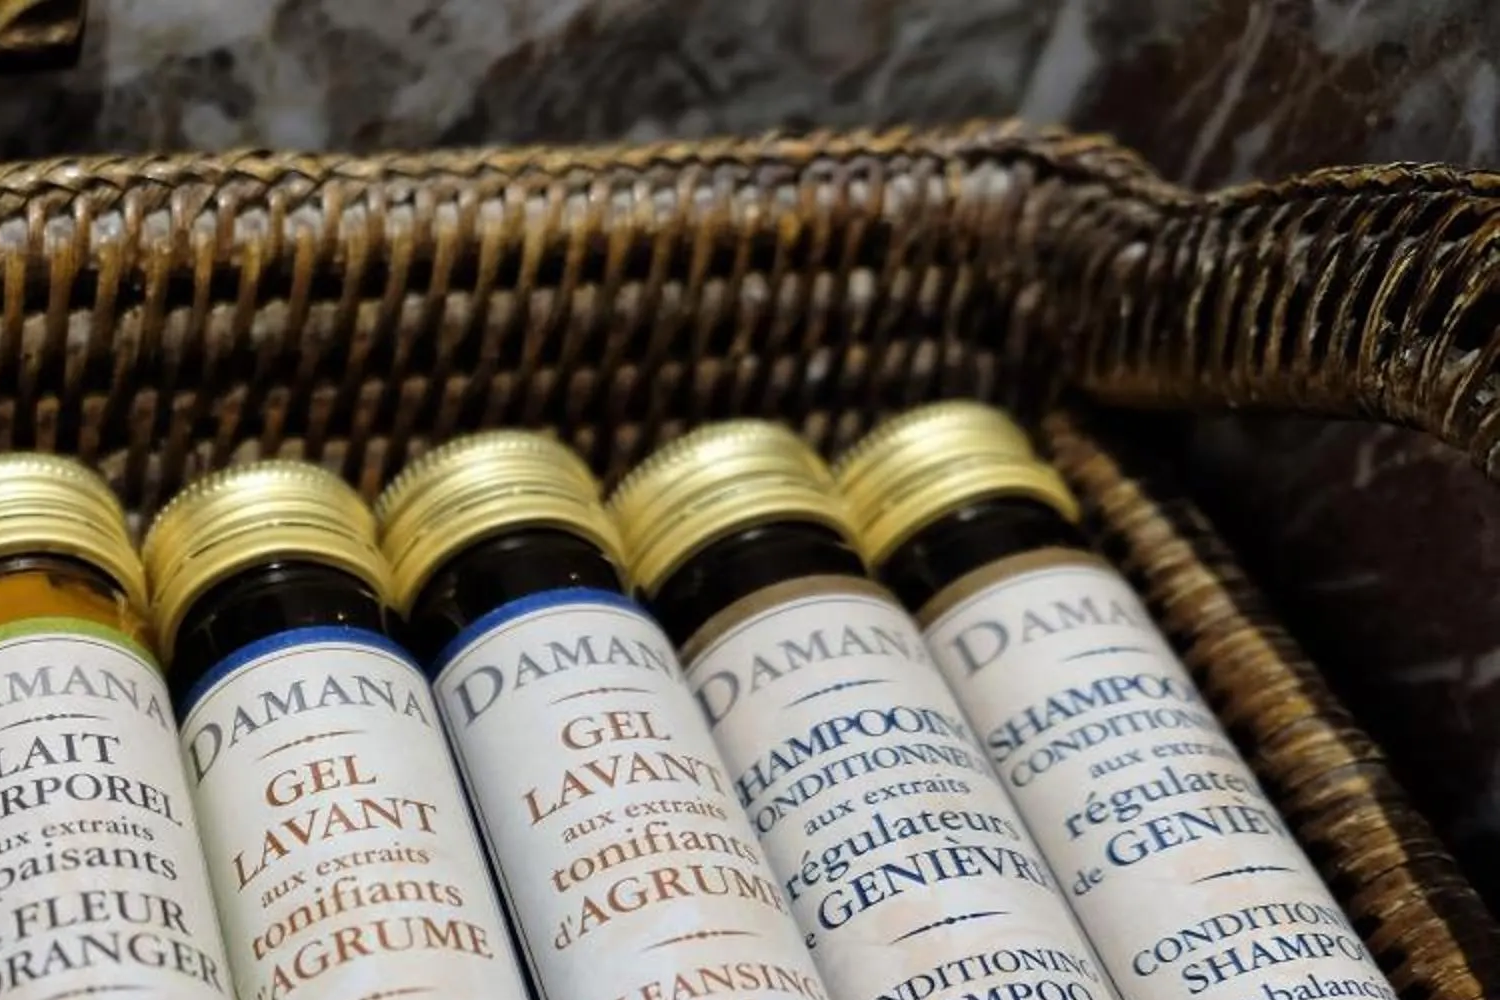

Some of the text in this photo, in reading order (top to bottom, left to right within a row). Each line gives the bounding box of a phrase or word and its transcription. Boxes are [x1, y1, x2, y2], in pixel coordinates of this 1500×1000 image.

[952, 594, 1142, 677] DAMA
[453, 634, 675, 727] DAMAN
[695, 625, 916, 729] DAMAN
[189, 675, 432, 787] DAMANA
[560, 710, 672, 751] GEL
[735, 706, 966, 811] HAMPOOIN
[1010, 706, 1210, 788] CONDITION
[1088, 746, 1145, 779] aux
[265, 754, 378, 808] GEL
[522, 751, 727, 827] LAVANT
[752, 743, 976, 836] ONDITIONNE
[803, 774, 971, 837] aux extraits
[1065, 765, 1248, 839] régulate
[41, 815, 155, 842] extraits
[232, 797, 438, 894] LAVANT
[551, 820, 760, 894] tonifiants
[561, 797, 728, 844] aux extraits
[785, 808, 1021, 901] régulateurs
[1073, 796, 1280, 897] de GENIÈ
[260, 842, 432, 909] aux extraits
[11, 890, 193, 941] FLEUR
[252, 875, 465, 962] tonifiants
[1132, 901, 1347, 977] CONDITION
[1180, 932, 1366, 996] SHAMPO
